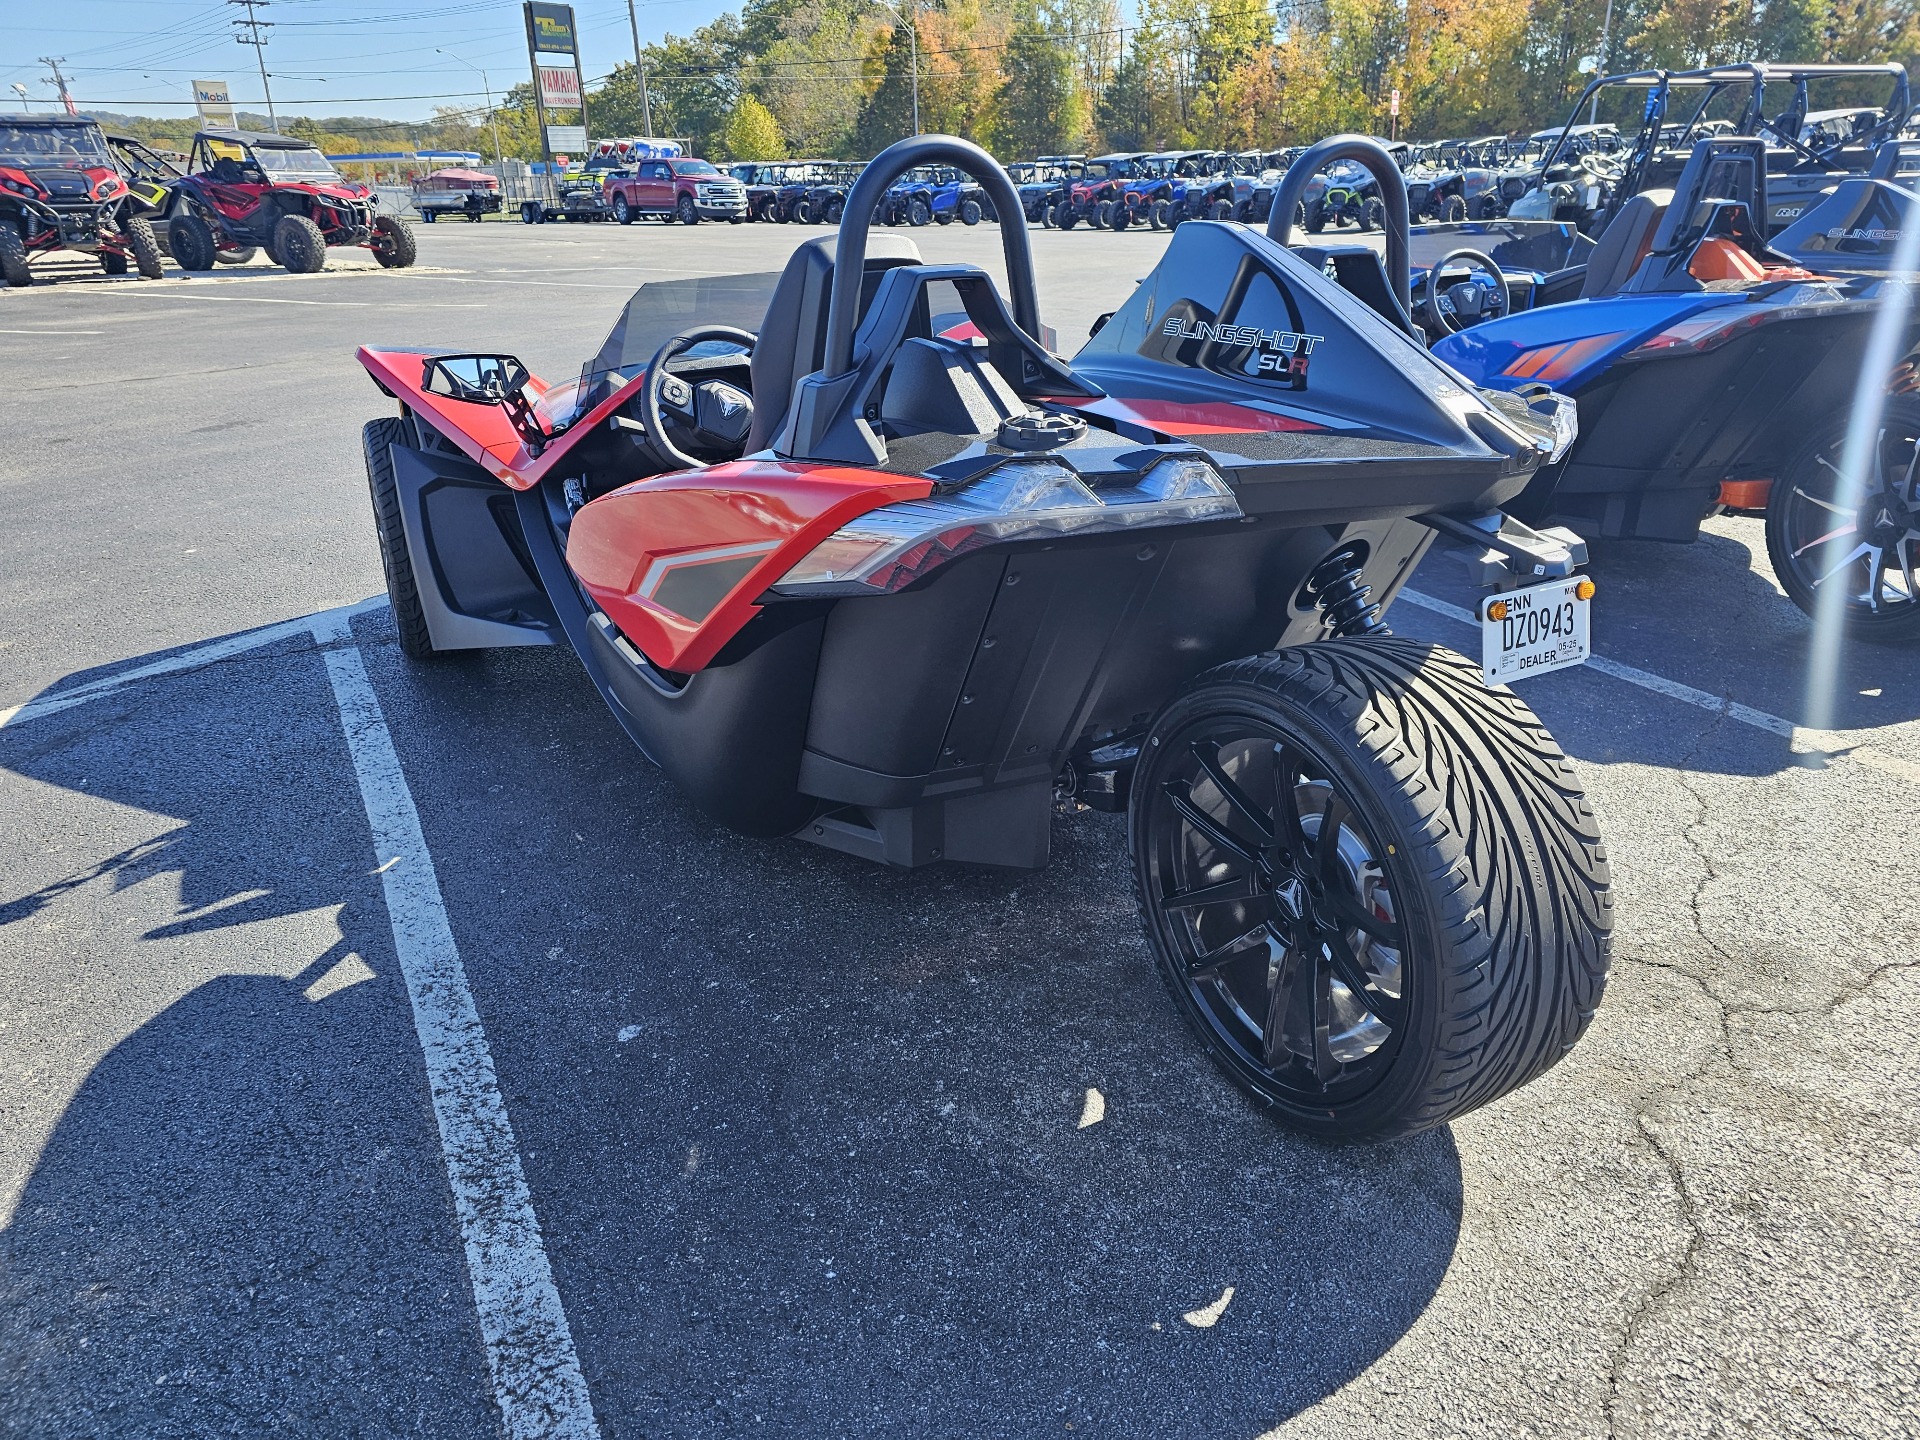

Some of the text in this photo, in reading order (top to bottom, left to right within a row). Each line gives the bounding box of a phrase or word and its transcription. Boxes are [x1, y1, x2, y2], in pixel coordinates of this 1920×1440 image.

[540, 70, 579, 93] YAMAHA
[199, 90, 229, 102] Mobil
[544, 97, 580, 105] WAVERUNNERS
[1163, 317, 1325, 355] SLINGSHOT
[1257, 353, 1310, 376] SLR
[1501, 593, 1532, 613] ENN
[1503, 602, 1574, 652] DZ0943
[1520, 650, 1557, 670] DEALER
